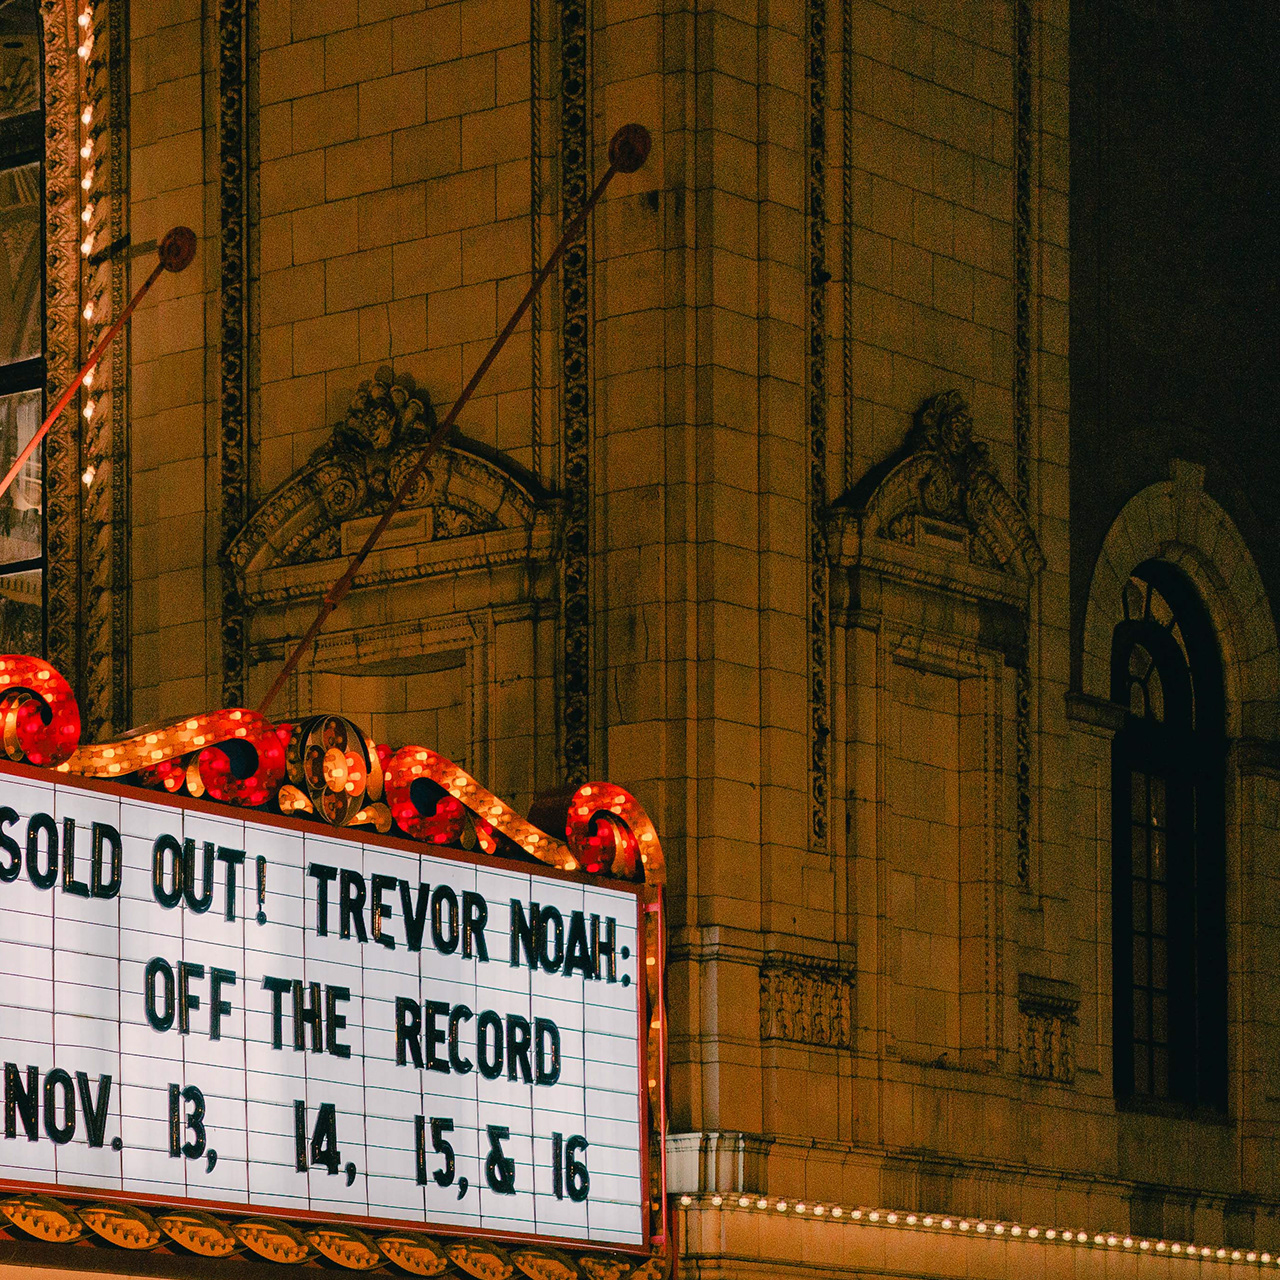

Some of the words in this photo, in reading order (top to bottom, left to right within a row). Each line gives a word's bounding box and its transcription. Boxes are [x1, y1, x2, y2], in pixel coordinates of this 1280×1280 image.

[152, 832, 269, 926] OUT!
[306, 861, 491, 964] TREVOR
[509, 897, 633, 988] NOAH:
[144, 956, 237, 1041] OFF
[261, 975, 353, 1059] THE
[394, 996, 563, 1087] RECORD
[3, 1061, 124, 1152] NOV.
[167, 1082, 218, 1174] 13,
[294, 1099, 358, 1186] 14,
[550, 1130, 591, 1203] 16
